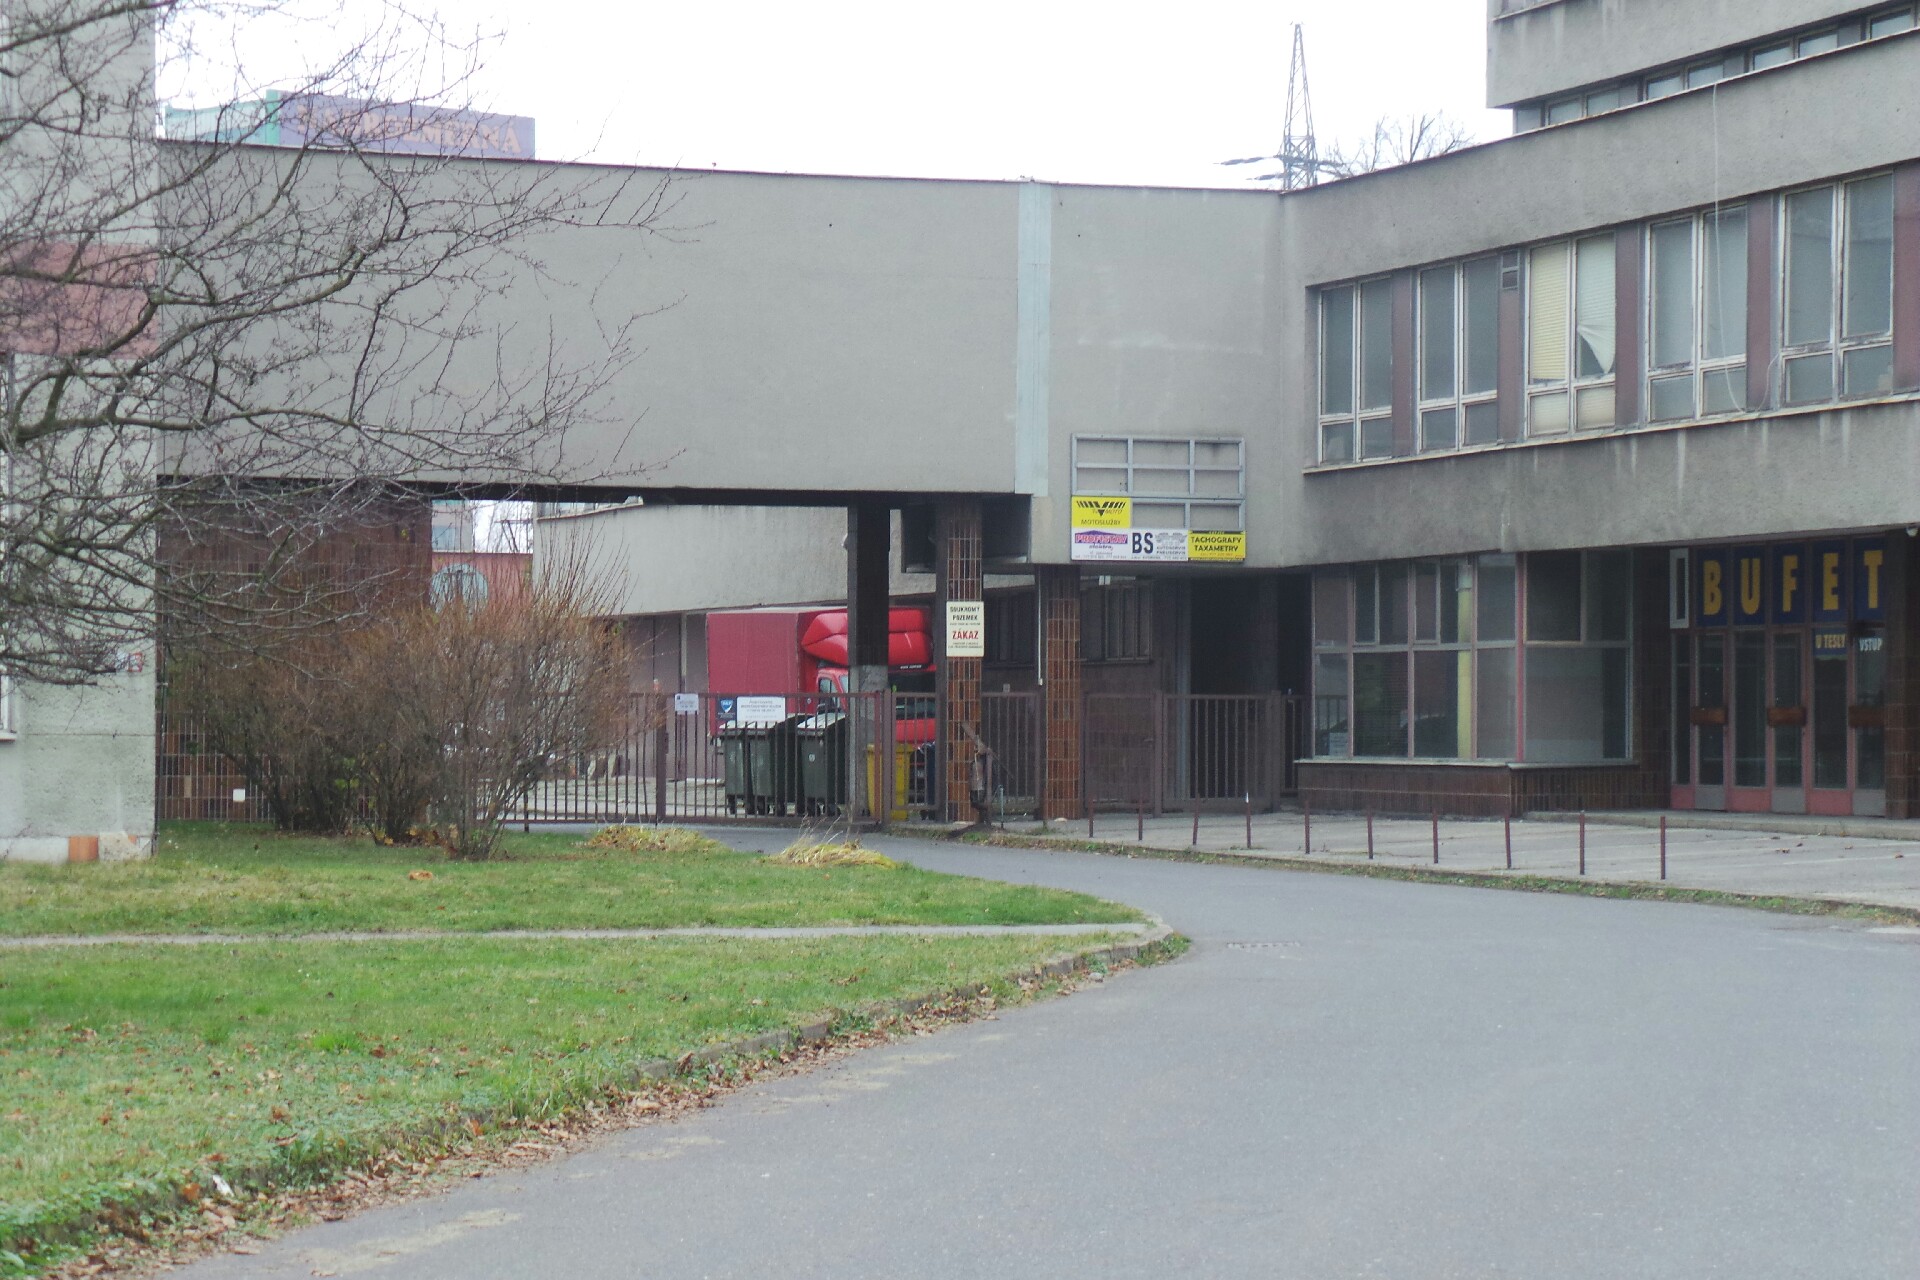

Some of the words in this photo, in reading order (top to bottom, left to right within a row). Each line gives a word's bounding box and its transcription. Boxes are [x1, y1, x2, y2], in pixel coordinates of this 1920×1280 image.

[1132, 532, 1154, 554] BS
[1190, 536, 1242, 544] TACHOGRAFY
[1194, 544, 1239, 552] TAXAMETRY
[1703, 550, 1883, 615] BUFET
[952, 628, 979, 639] ZÁKAZ
[1859, 638, 1882, 651] VSTUP
